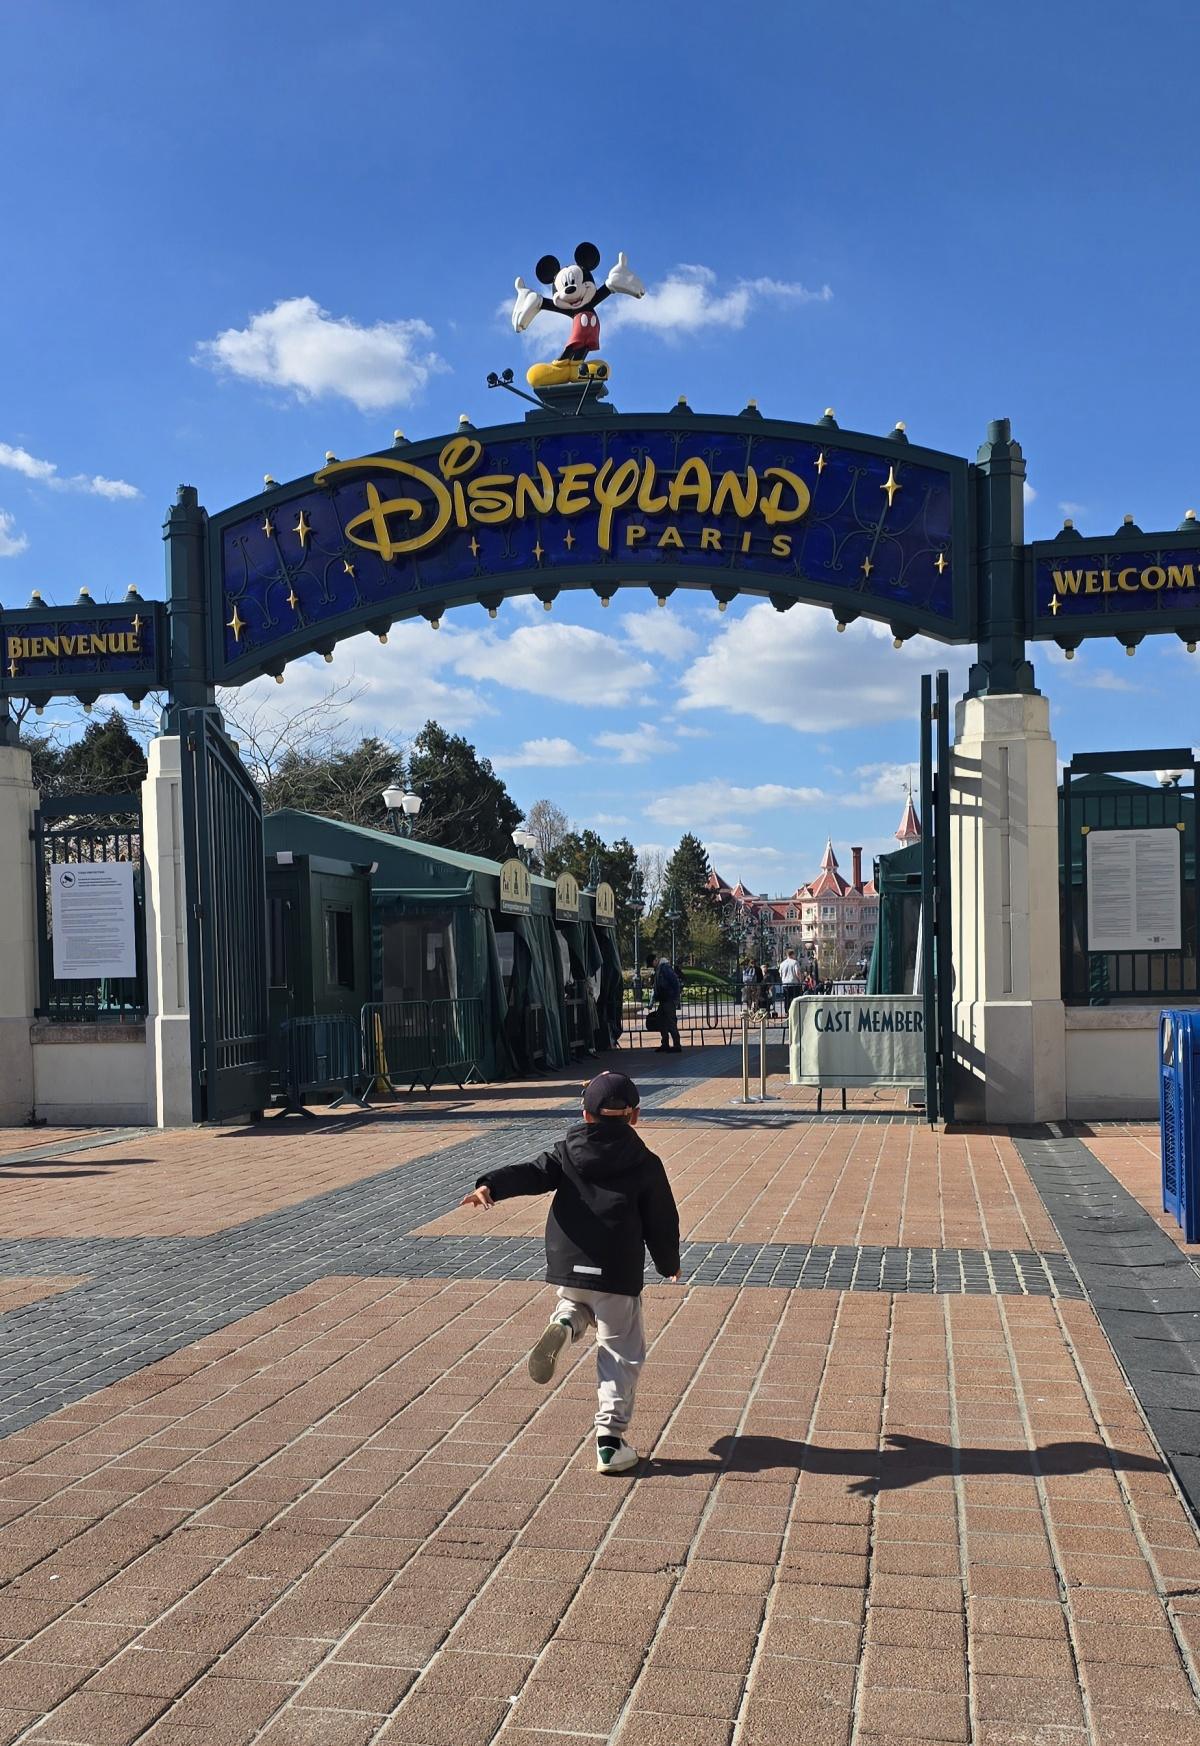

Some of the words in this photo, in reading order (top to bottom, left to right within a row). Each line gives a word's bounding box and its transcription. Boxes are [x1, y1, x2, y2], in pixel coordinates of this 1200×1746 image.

[626, 524, 793, 557] PARIS
[1052, 564, 1200, 595] WELCOM
[7, 632, 141, 659] BIENVENUE
[814, 1008, 852, 1033] CAST
